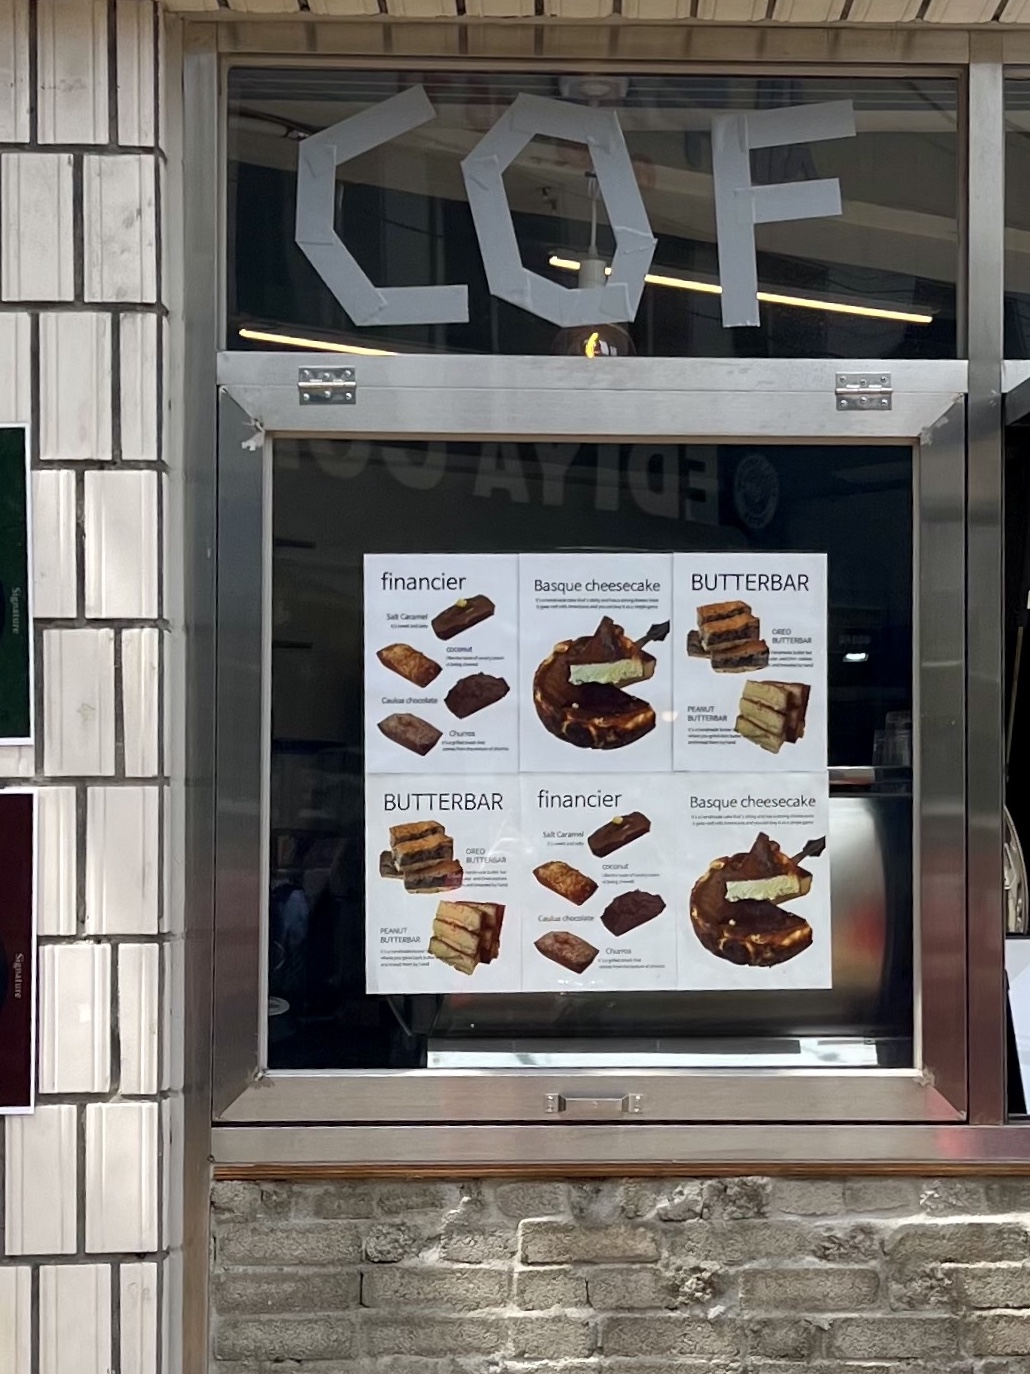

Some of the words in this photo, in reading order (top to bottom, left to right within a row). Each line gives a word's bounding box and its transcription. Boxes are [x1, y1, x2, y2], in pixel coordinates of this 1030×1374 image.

[380, 571, 467, 591] financier
[534, 579, 582, 595] Basque
[585, 578, 661, 592] cheesecake
[691, 573, 809, 592] BUTTERBAR
[10, 587, 21, 635] Signature
[384, 793, 503, 811] BUTTERBAR
[537, 789, 623, 809] financier
[690, 796, 738, 811] Basque
[740, 794, 816, 808] cheesecake
[380, 936, 421, 944] BUTTERBAR
[13, 953, 24, 999] Signature
